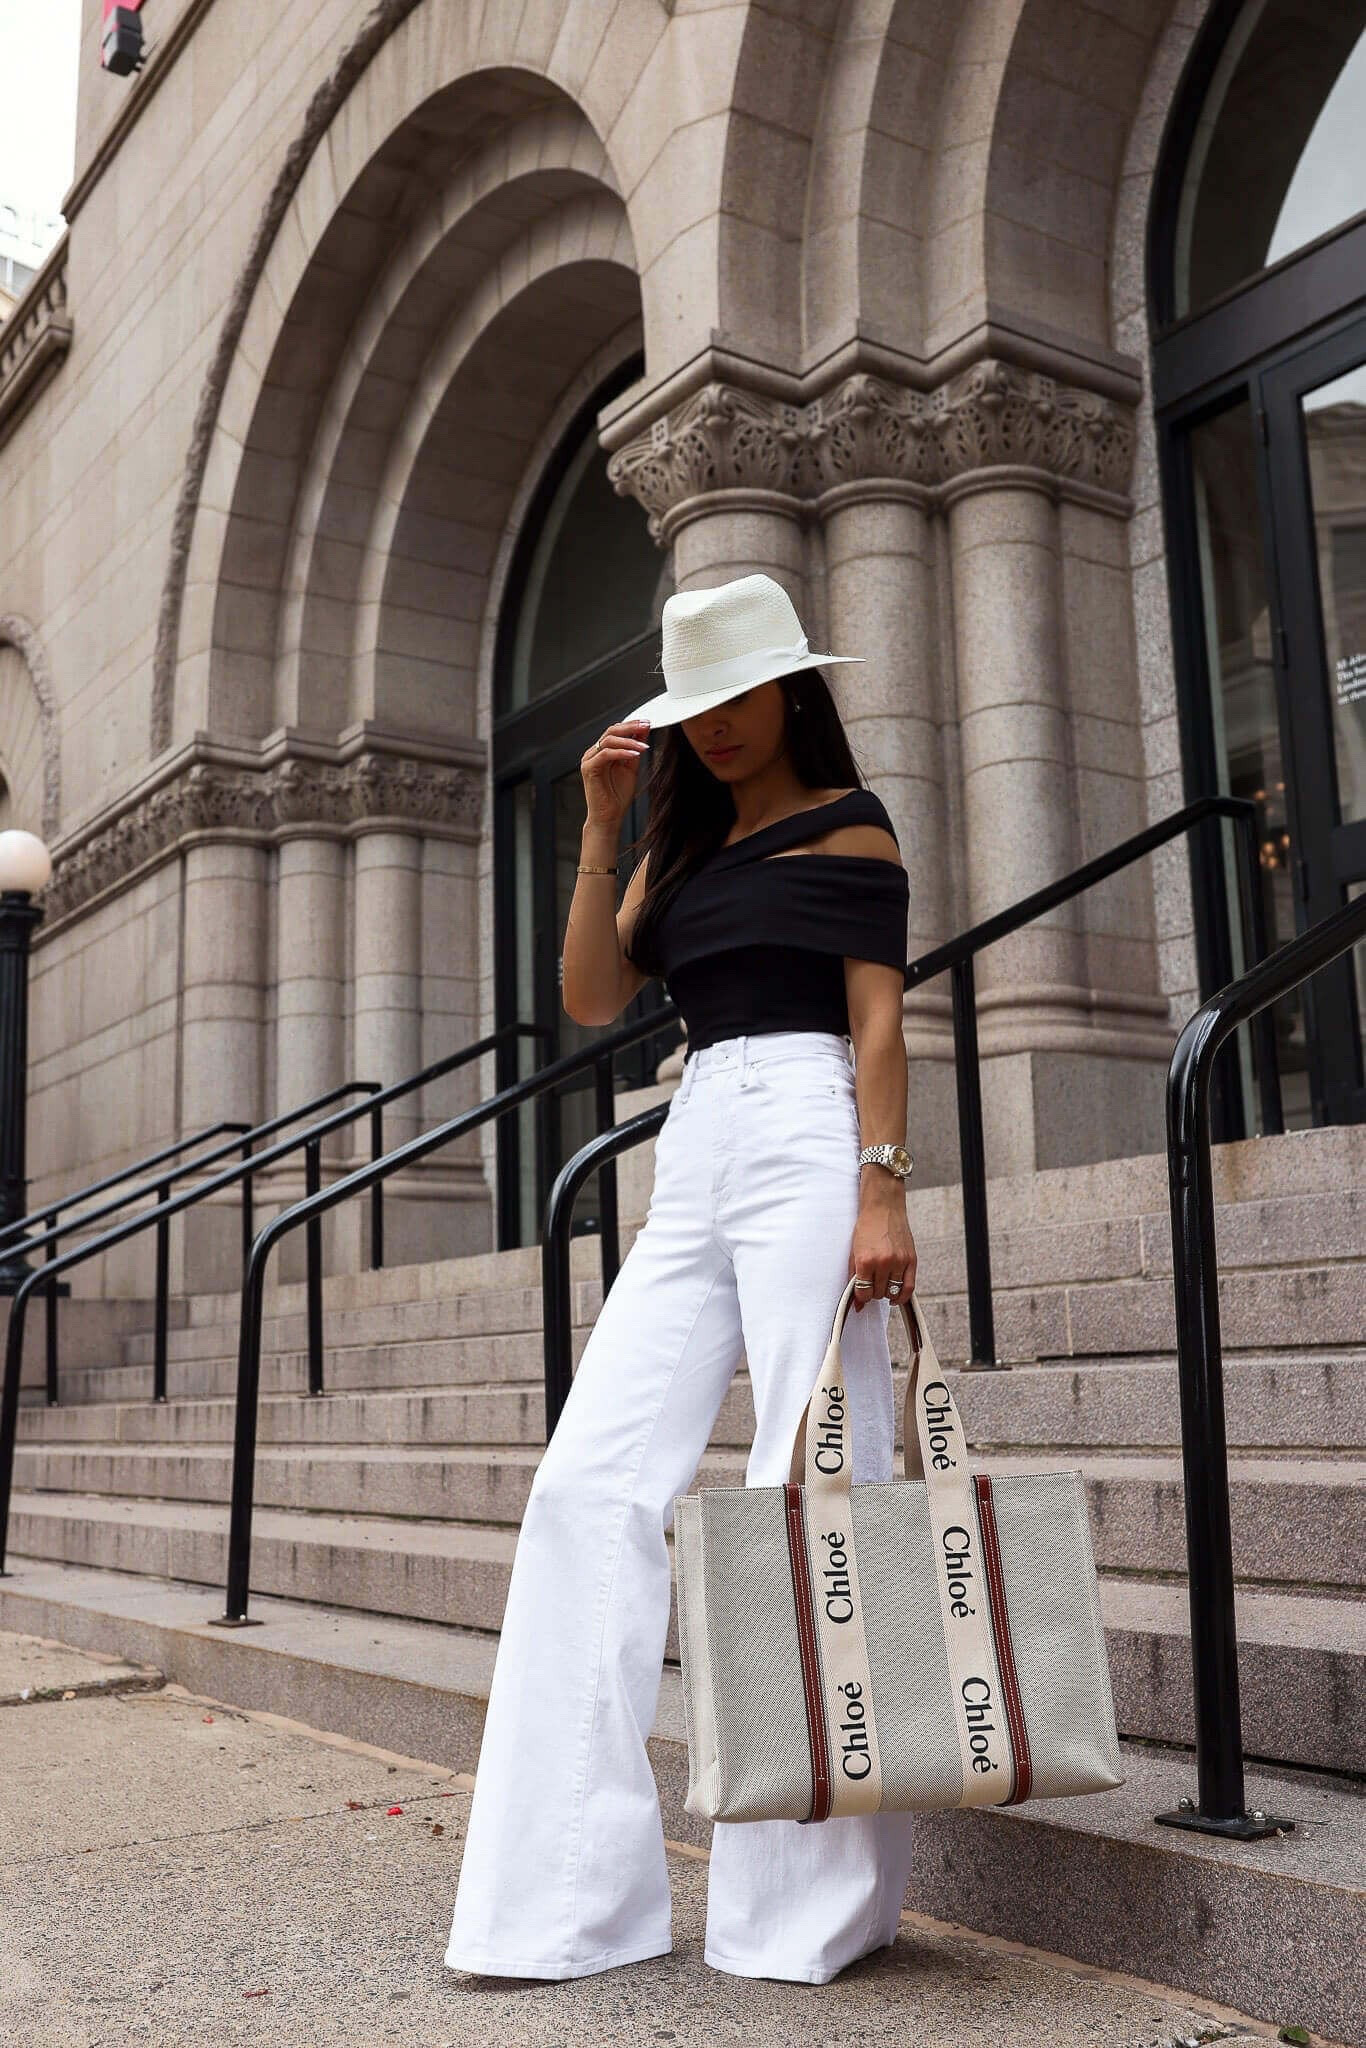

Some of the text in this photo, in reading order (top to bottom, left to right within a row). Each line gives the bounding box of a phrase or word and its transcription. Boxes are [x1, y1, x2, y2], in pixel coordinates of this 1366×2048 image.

[815, 1386, 845, 1475] Chloé
[923, 1381, 957, 1471] Chloé
[821, 1531, 854, 1624] Chloé
[942, 1526, 976, 1618] Chloé
[838, 1681, 871, 1781] Chloé
[961, 1677, 998, 1774] Chloé
